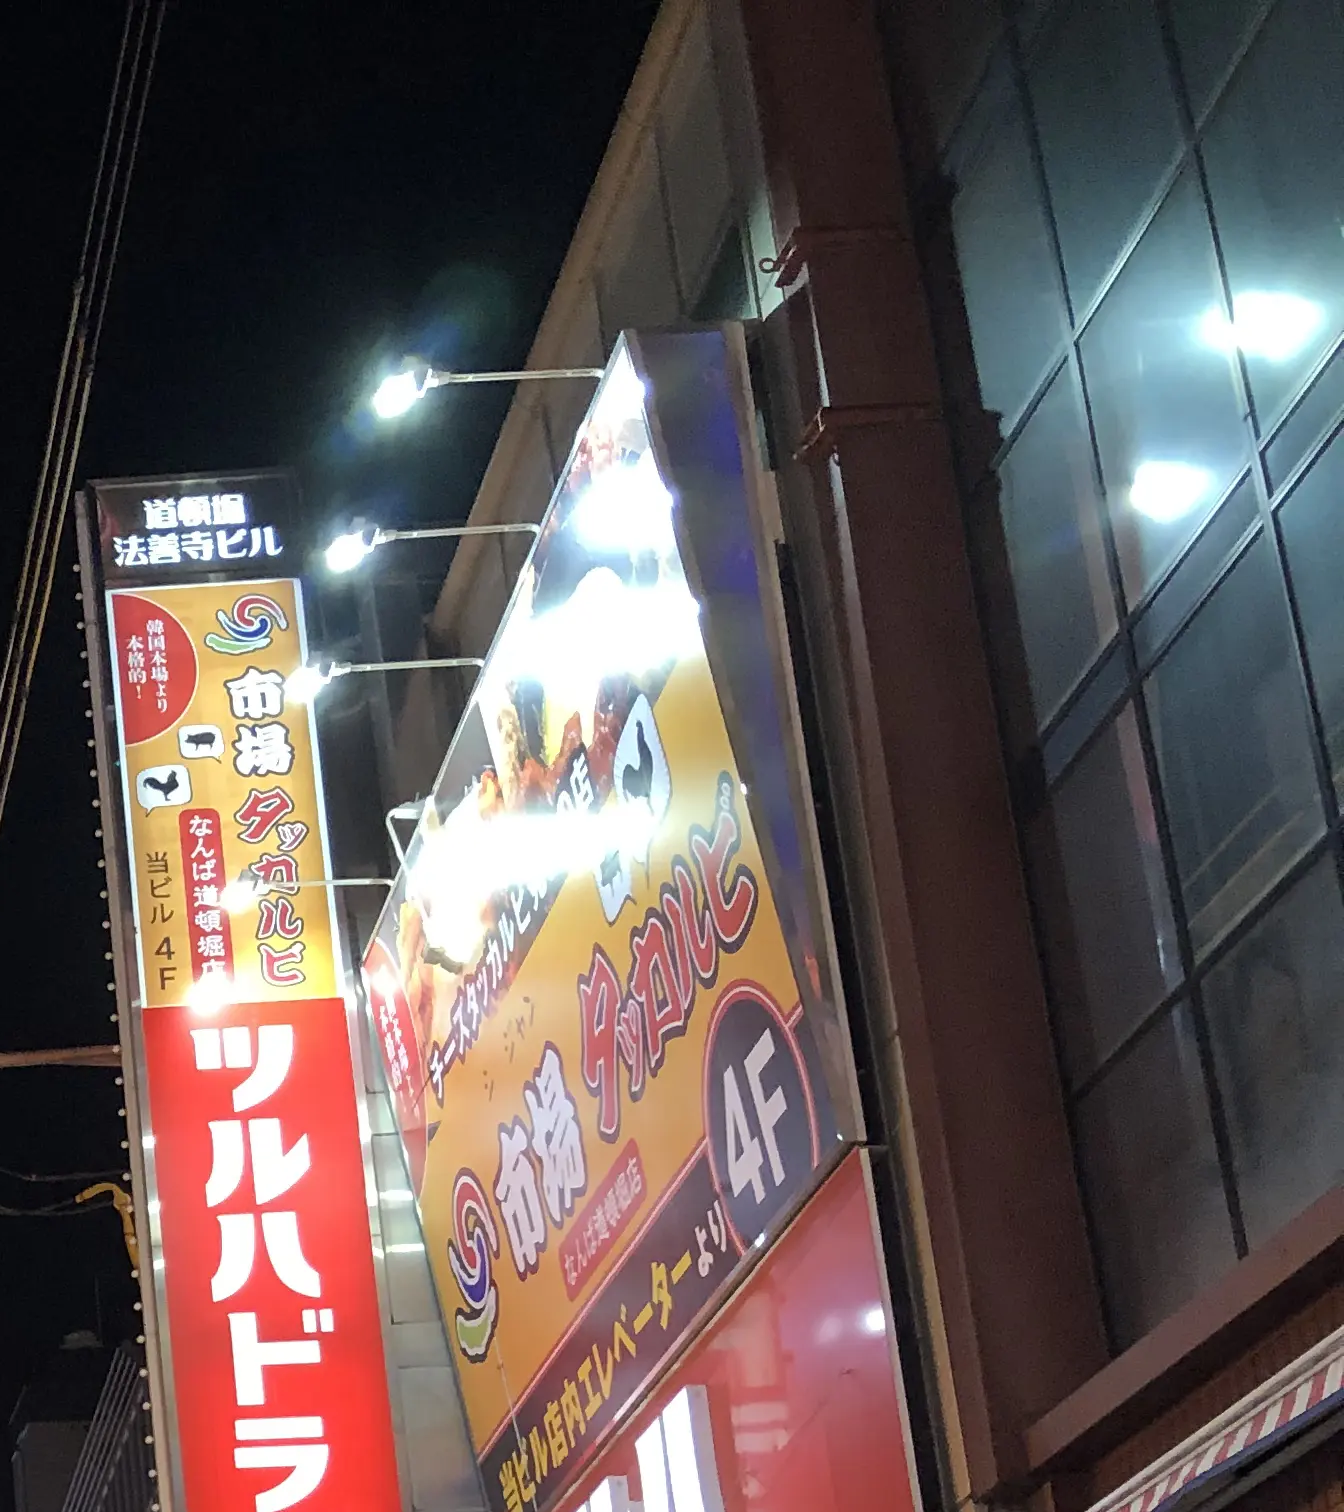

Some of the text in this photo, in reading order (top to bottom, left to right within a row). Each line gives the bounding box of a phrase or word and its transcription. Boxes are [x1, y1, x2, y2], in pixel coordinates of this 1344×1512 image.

[112, 526, 283, 567] 法善寺ビル
[147, 620, 169, 713] 韓国本場より
[723, 1027, 789, 1206] 4F
